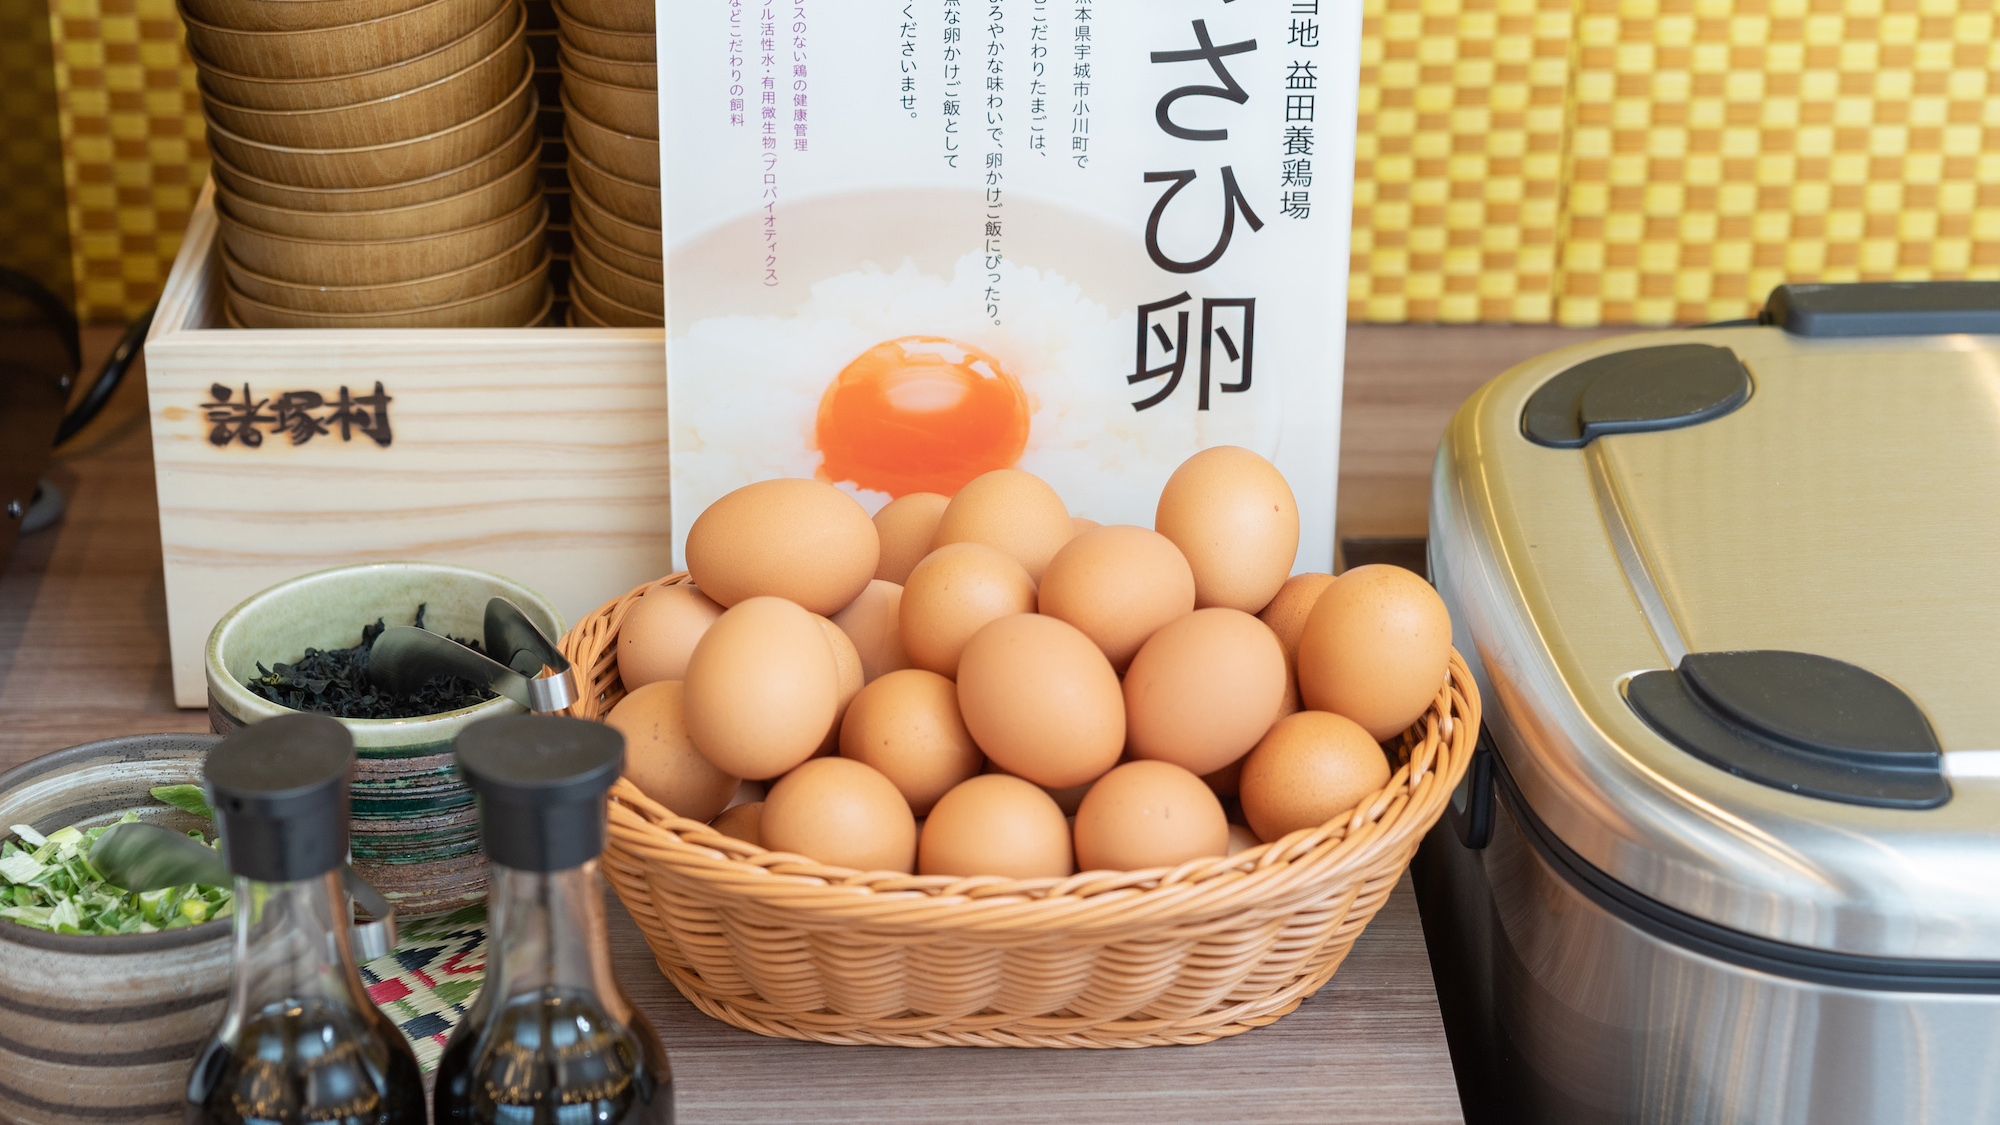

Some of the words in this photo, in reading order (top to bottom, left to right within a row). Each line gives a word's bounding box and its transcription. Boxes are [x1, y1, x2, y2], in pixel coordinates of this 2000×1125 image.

[900, 0, 917, 118] くださいませ。
[1030, 0, 1048, 157] こだわりたまごは、
[1072, 0, 1092, 168] 本県宇城市小川町で
[985, 0, 1004, 326] ろやかな味わいで、卵かけご飯にぴったり。
[1127, 0, 1264, 411] さひ卵
[1280, 60, 1318, 219] 益田養鶏場
[200, 381, 392, 447] 諸塚村
